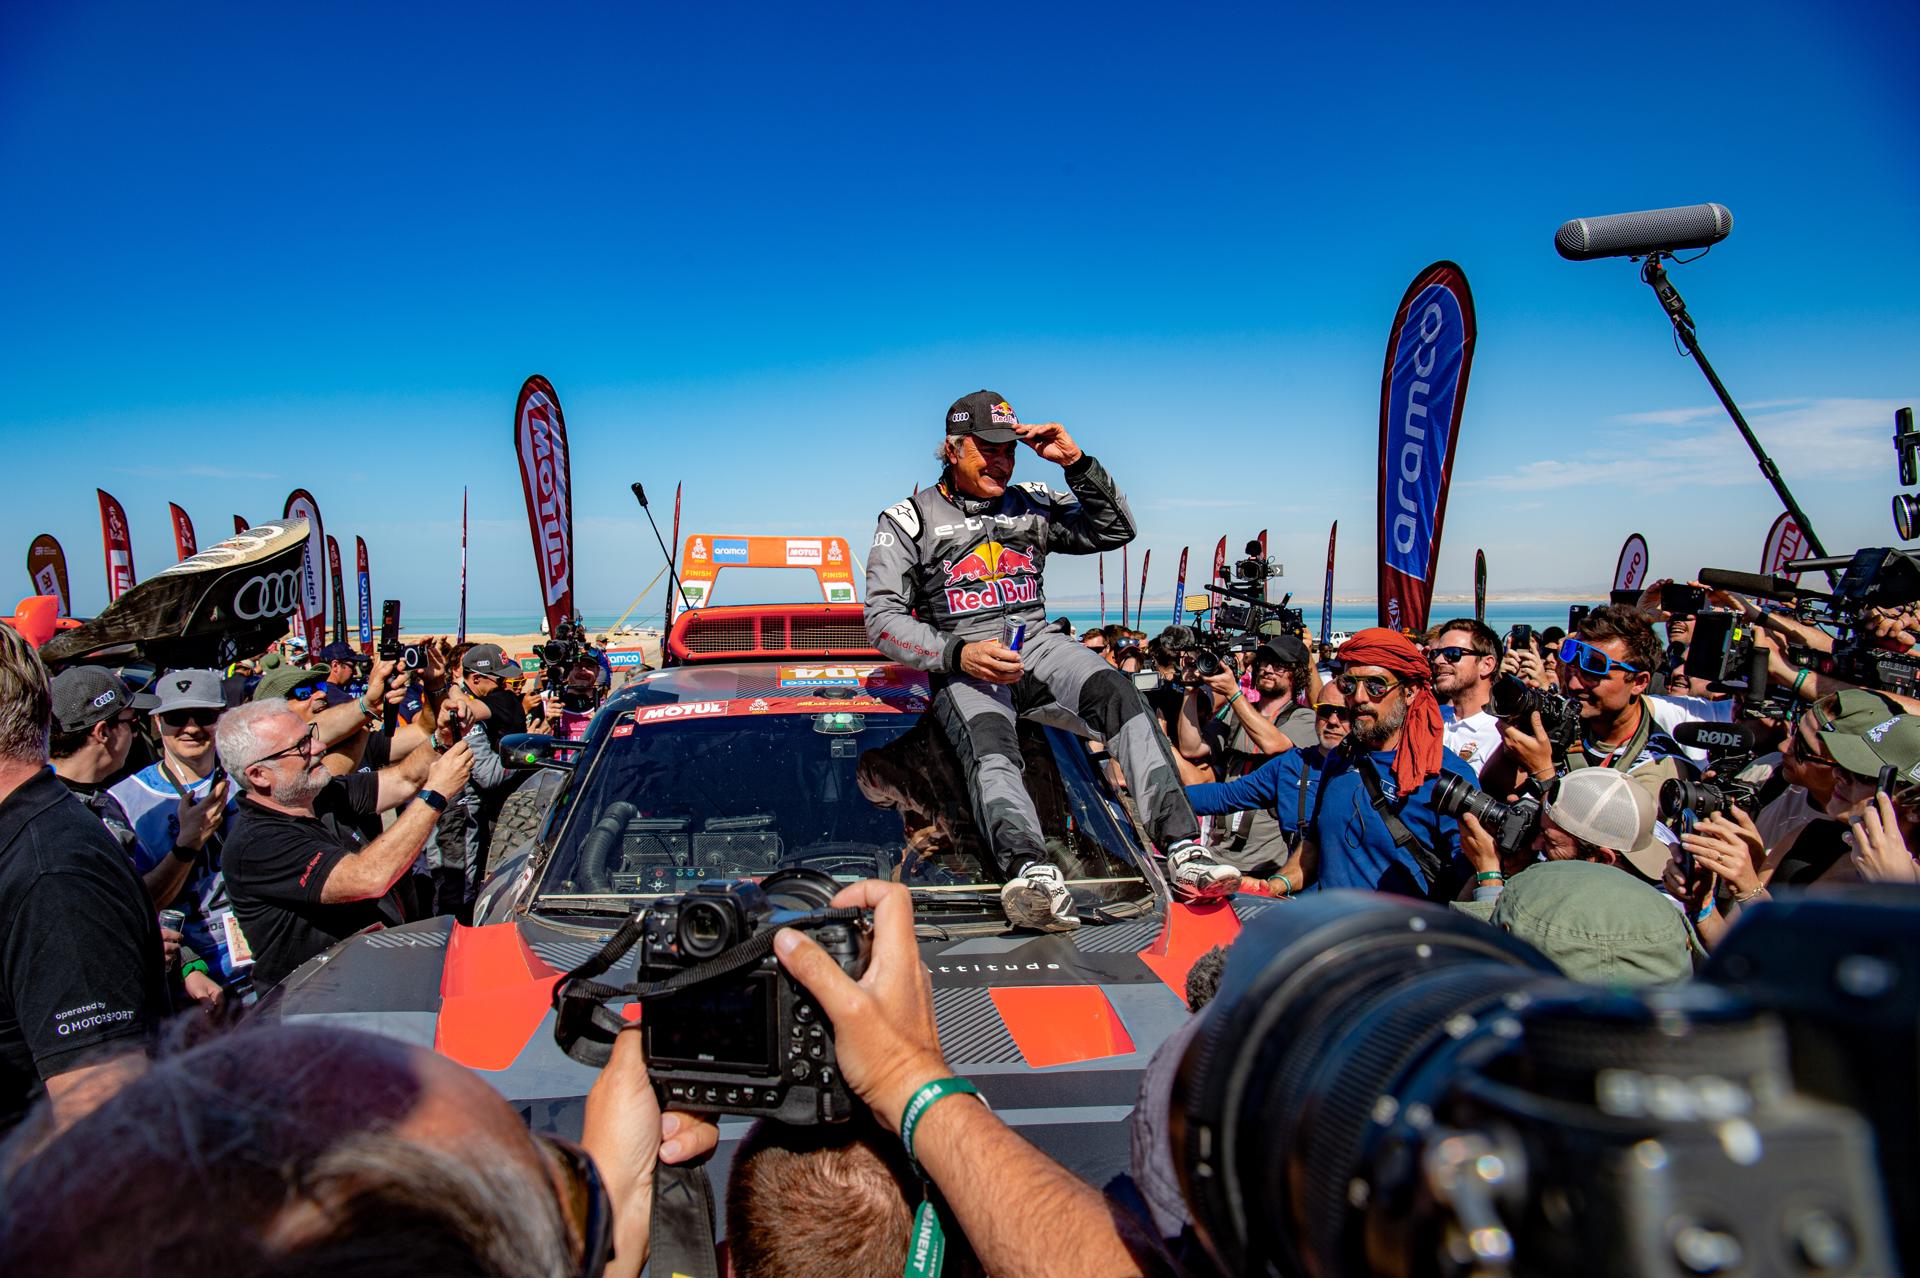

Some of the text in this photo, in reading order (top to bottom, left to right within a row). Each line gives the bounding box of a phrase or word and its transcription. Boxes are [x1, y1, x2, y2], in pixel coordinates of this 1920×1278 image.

[1393, 302, 1442, 554] aramco
[532, 418, 563, 577] MOTUL
[714, 547, 747, 556] aramco
[789, 548, 819, 556] MOTUL
[1775, 525, 1798, 573] TUL
[685, 569, 712, 577] FINISH
[822, 571, 849, 579] FINISH
[945, 576, 1037, 614] Red Bull
[361, 577, 371, 638] aramco
[889, 635, 940, 658] Audi Sport
[608, 654, 638, 663] amco
[643, 702, 722, 720] MOTUL
[1696, 728, 1743, 748] RØDE
[55, 1001, 106, 1020] operated by
[902, 1083, 943, 1153] PERMANE
[912, 1203, 935, 1272] MANENT
